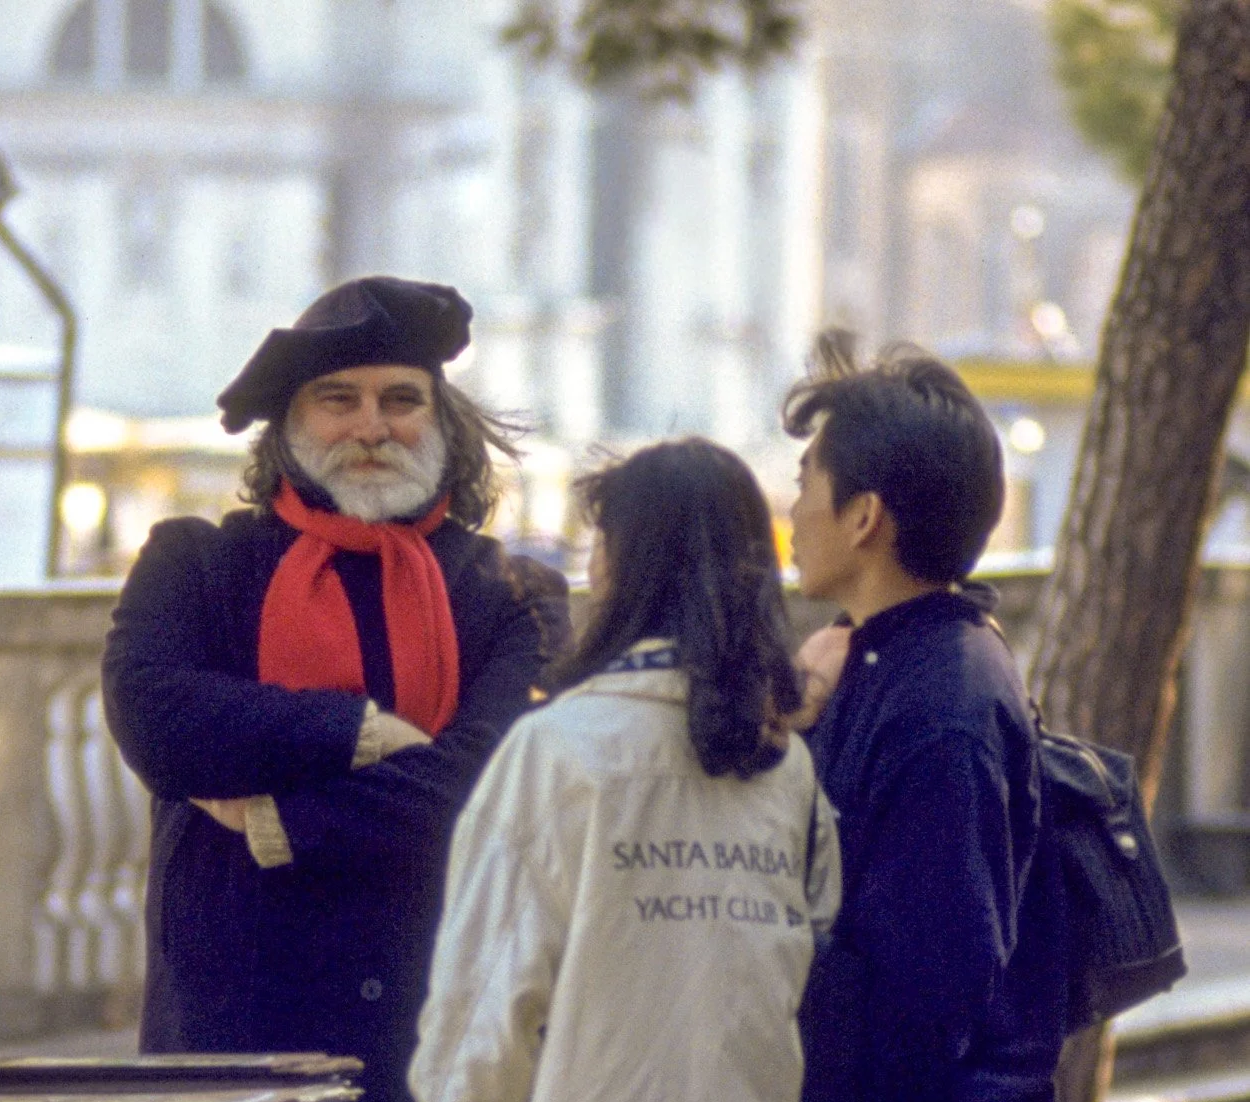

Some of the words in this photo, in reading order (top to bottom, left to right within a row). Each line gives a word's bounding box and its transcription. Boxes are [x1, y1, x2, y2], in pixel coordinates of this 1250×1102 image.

[613, 839, 709, 871] SANTA
[714, 842, 799, 877] BARBA
[635, 896, 720, 921] YACHT
[727, 898, 778, 923] CLUB
